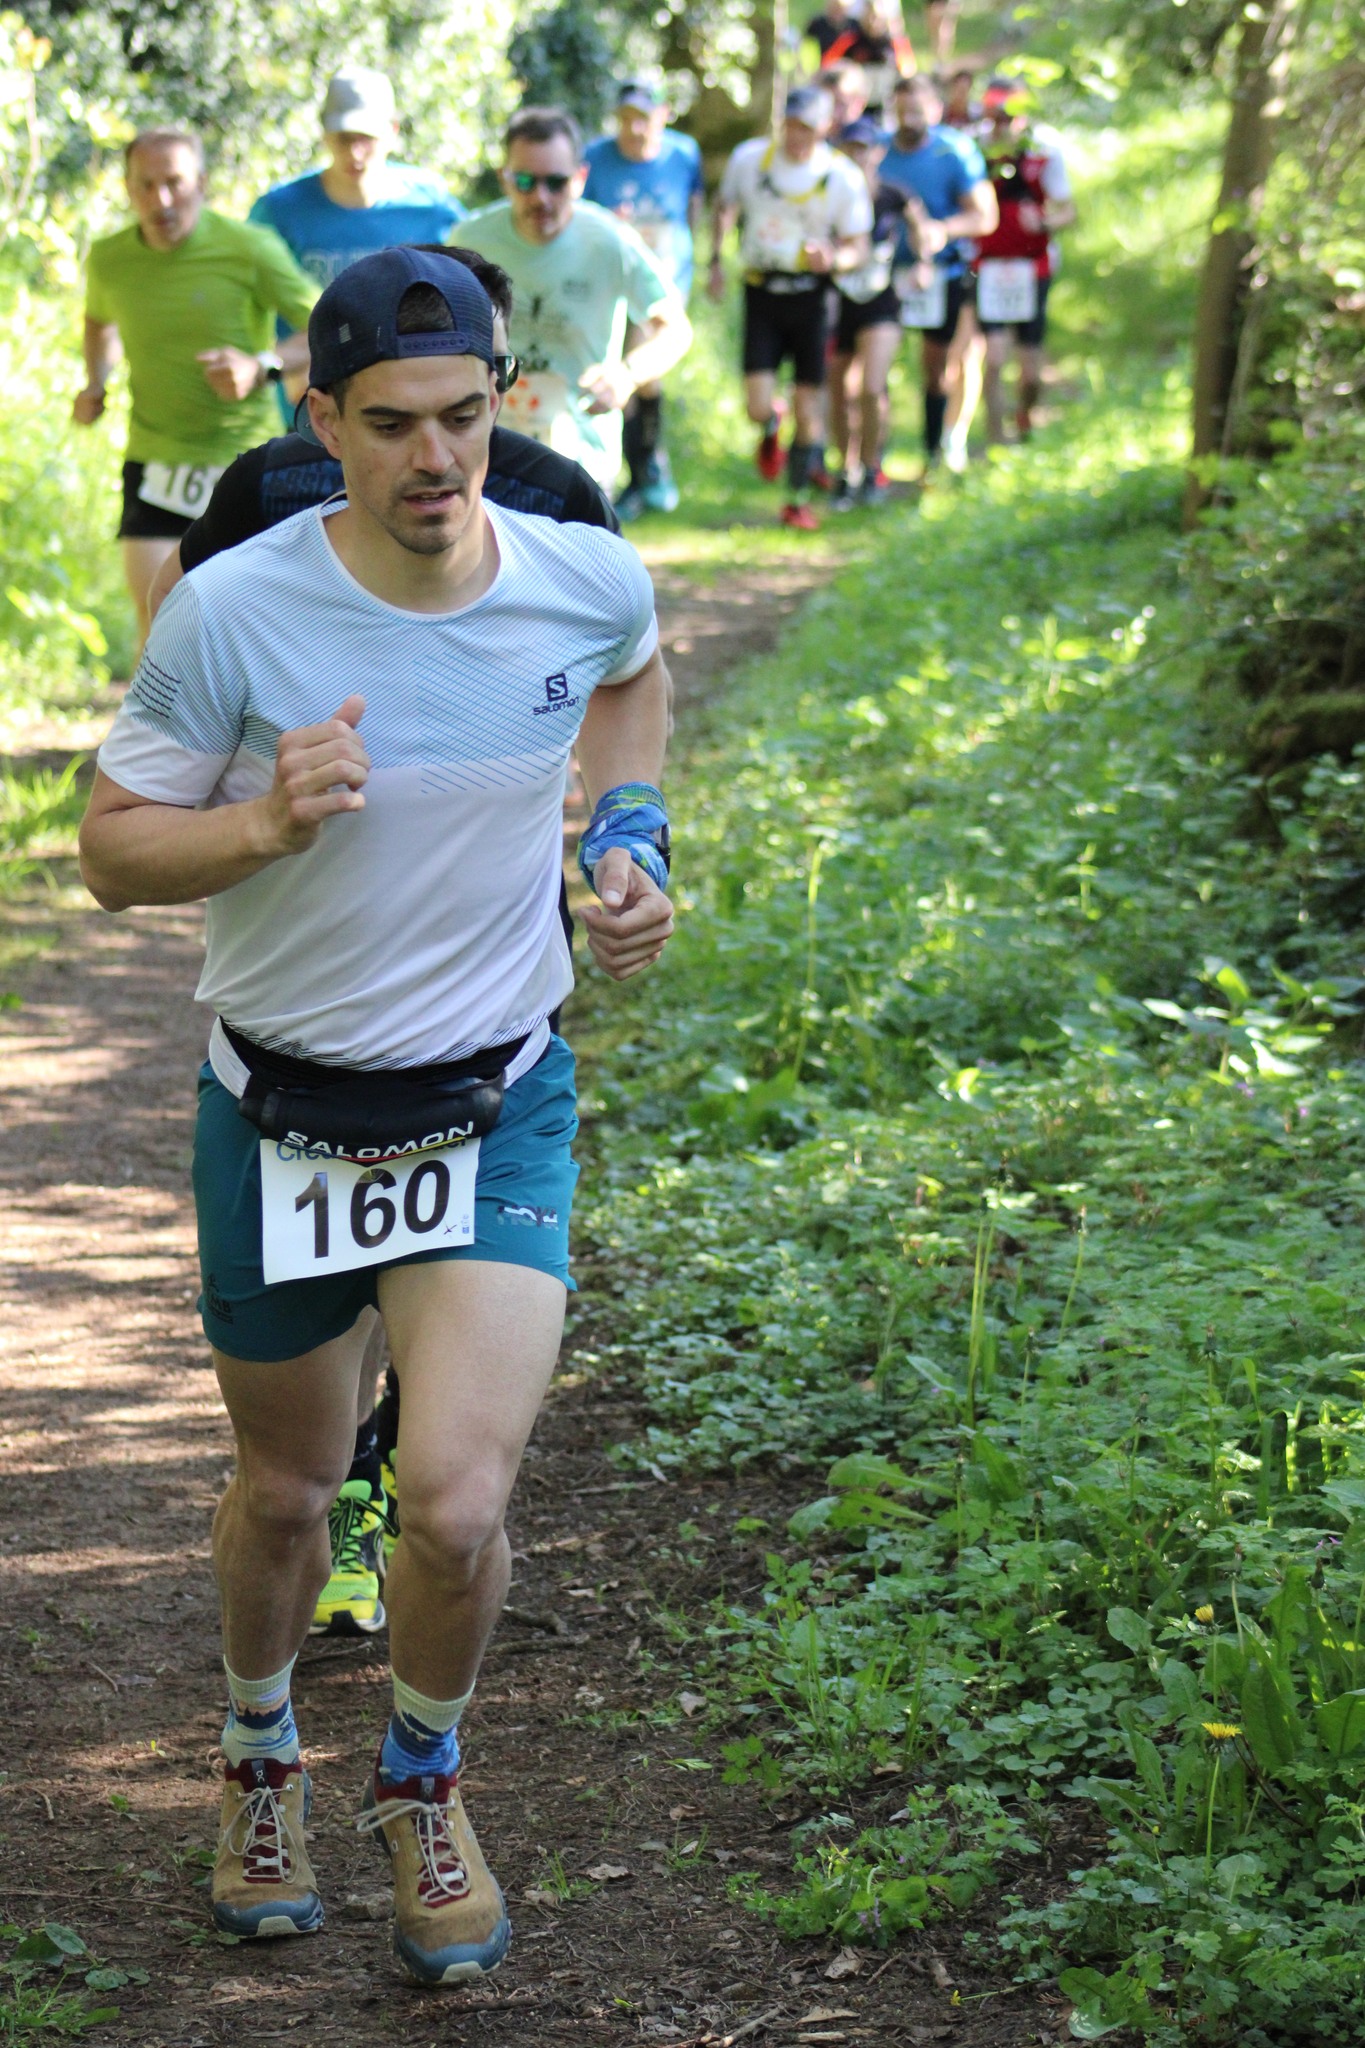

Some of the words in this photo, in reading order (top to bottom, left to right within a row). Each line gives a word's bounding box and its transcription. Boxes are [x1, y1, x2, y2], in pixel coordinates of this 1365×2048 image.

[164, 464, 218, 506] 16
[284, 1120, 474, 1159] SALOMON
[295, 1159, 451, 1259] 160
